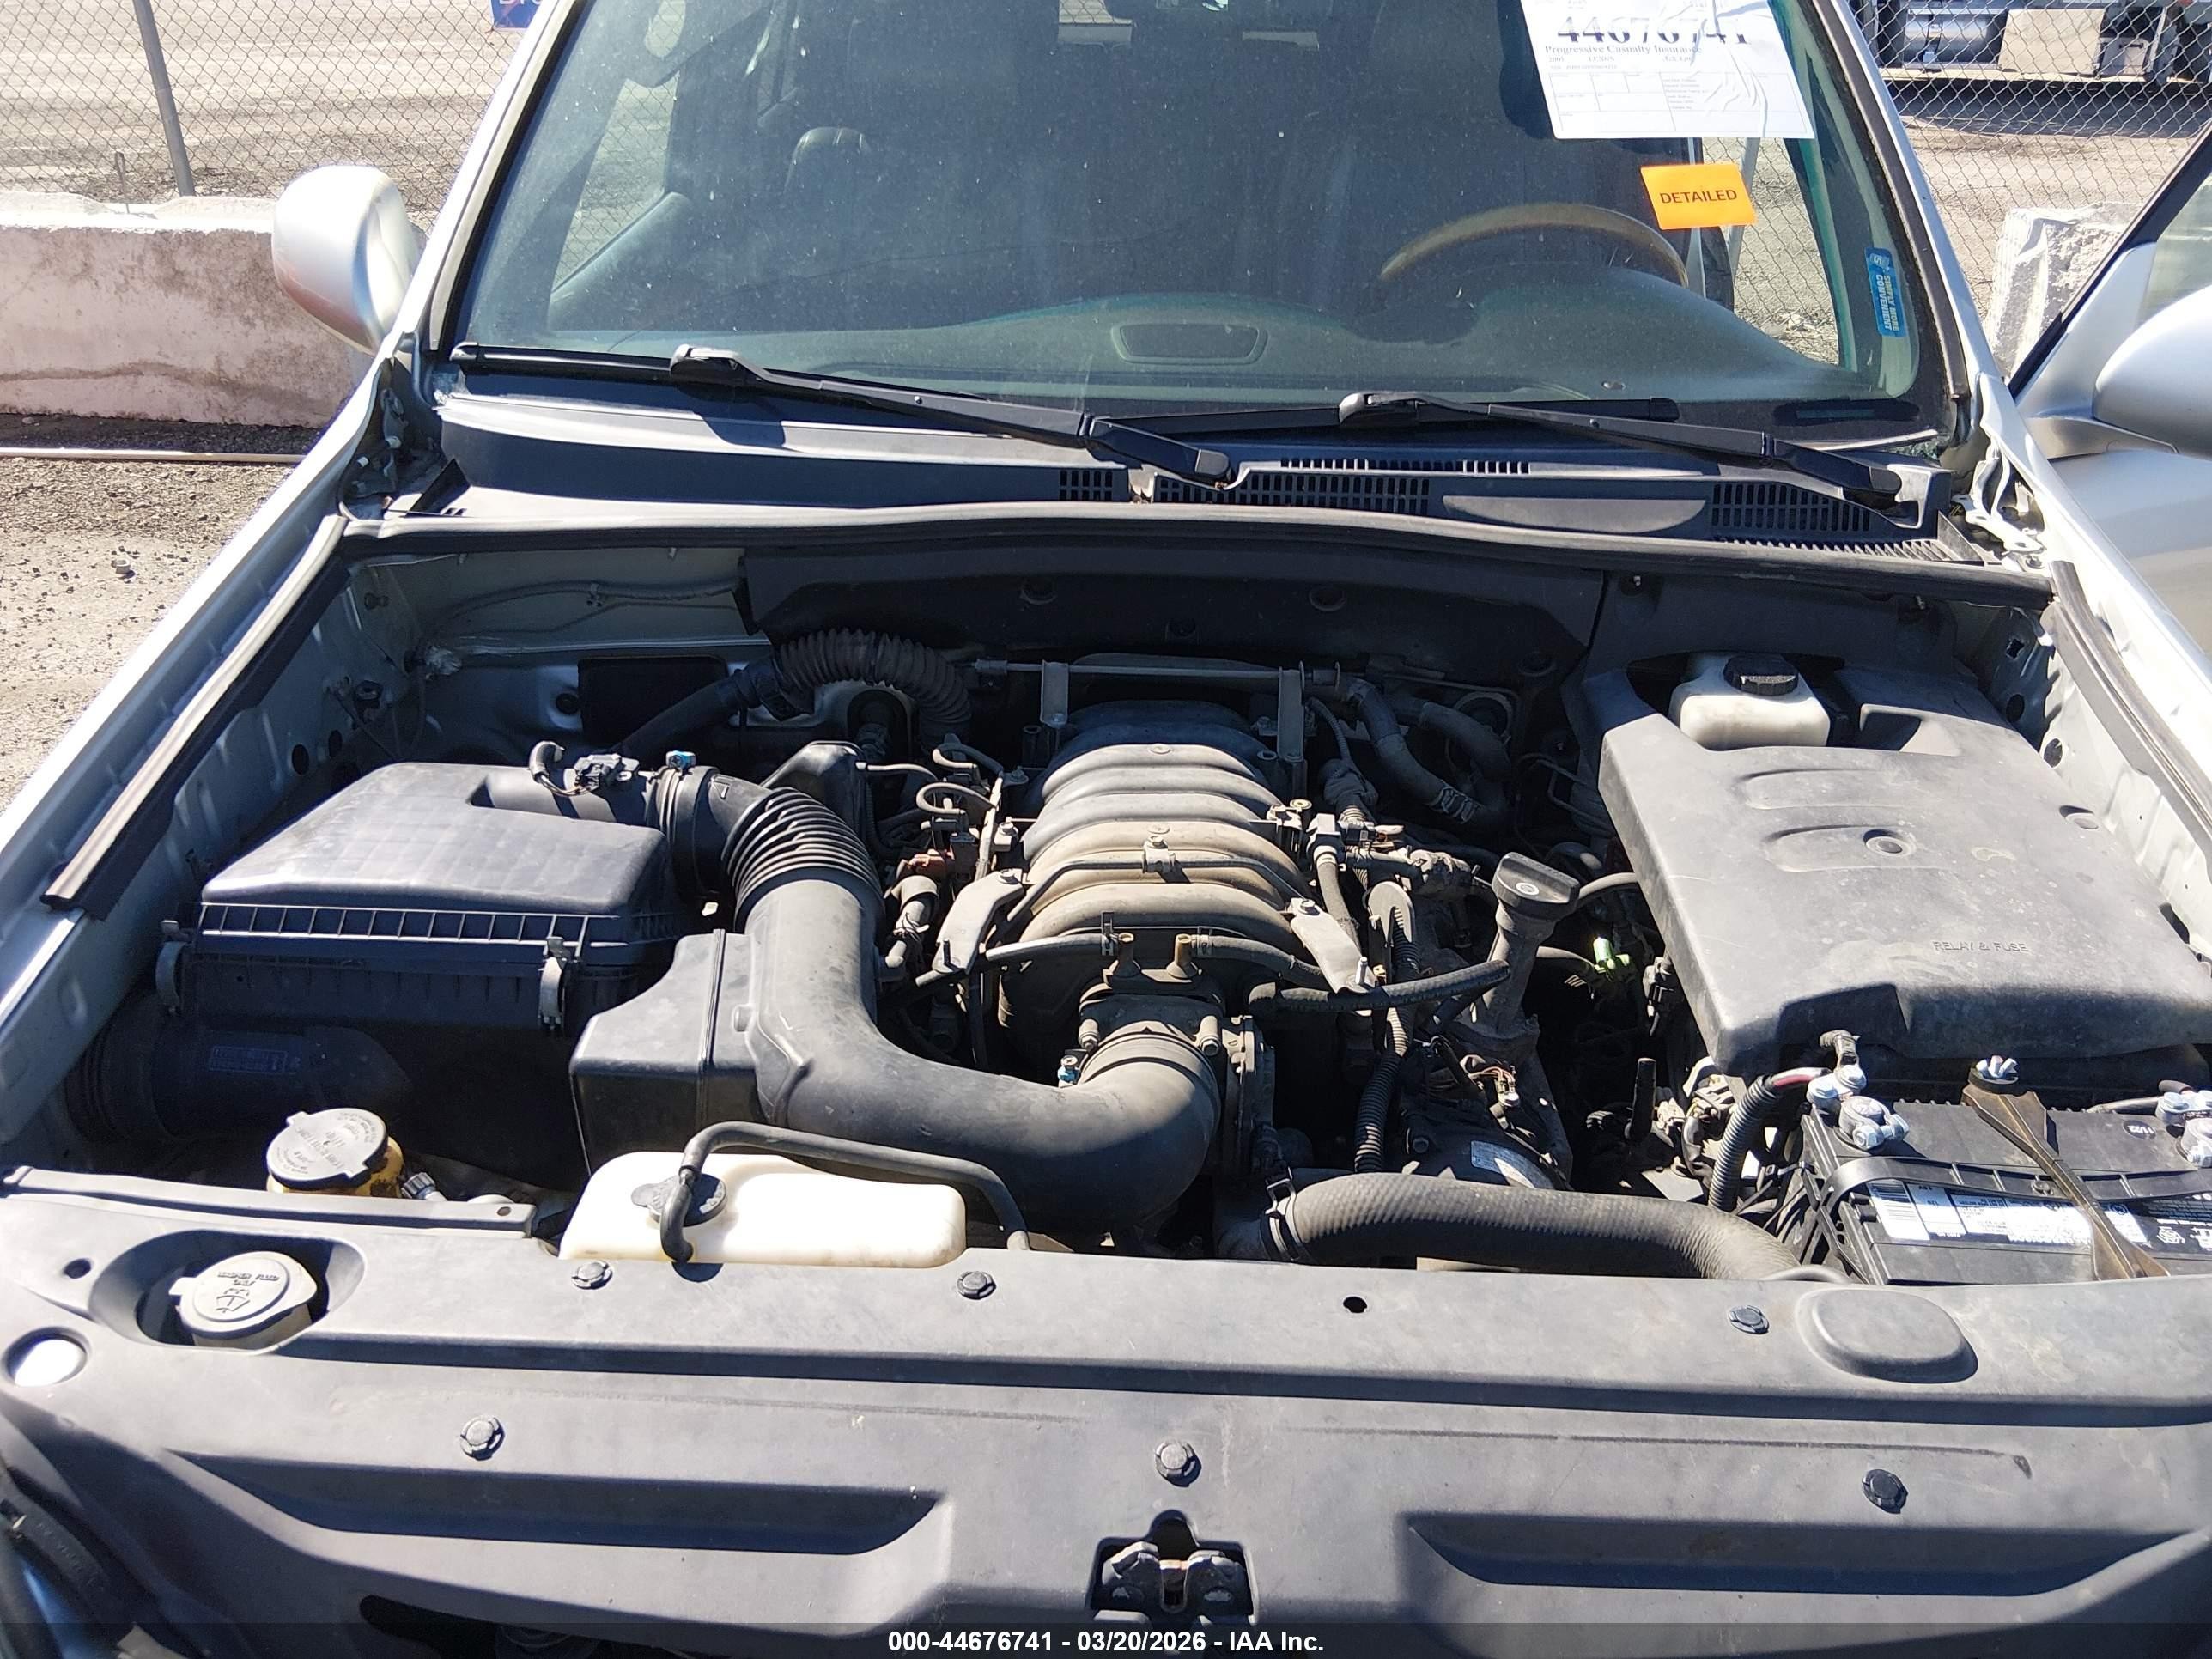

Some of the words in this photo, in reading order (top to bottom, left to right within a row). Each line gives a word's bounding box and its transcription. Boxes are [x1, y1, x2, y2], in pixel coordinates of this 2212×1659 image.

[1545, 45, 1605, 56] Progressive
[1607, 45, 1651, 56] Casualty
[1659, 189, 1738, 205] DETAILED
[1875, 274, 1893, 331] CONVENIENT
[1889, 307, 1900, 331] MORE
[1933, 941, 1974, 951] RELAY
[1978, 942, 1990, 951] &
[1993, 942, 2029, 952] FUSE
[255, 1273, 280, 1282] FLUID
